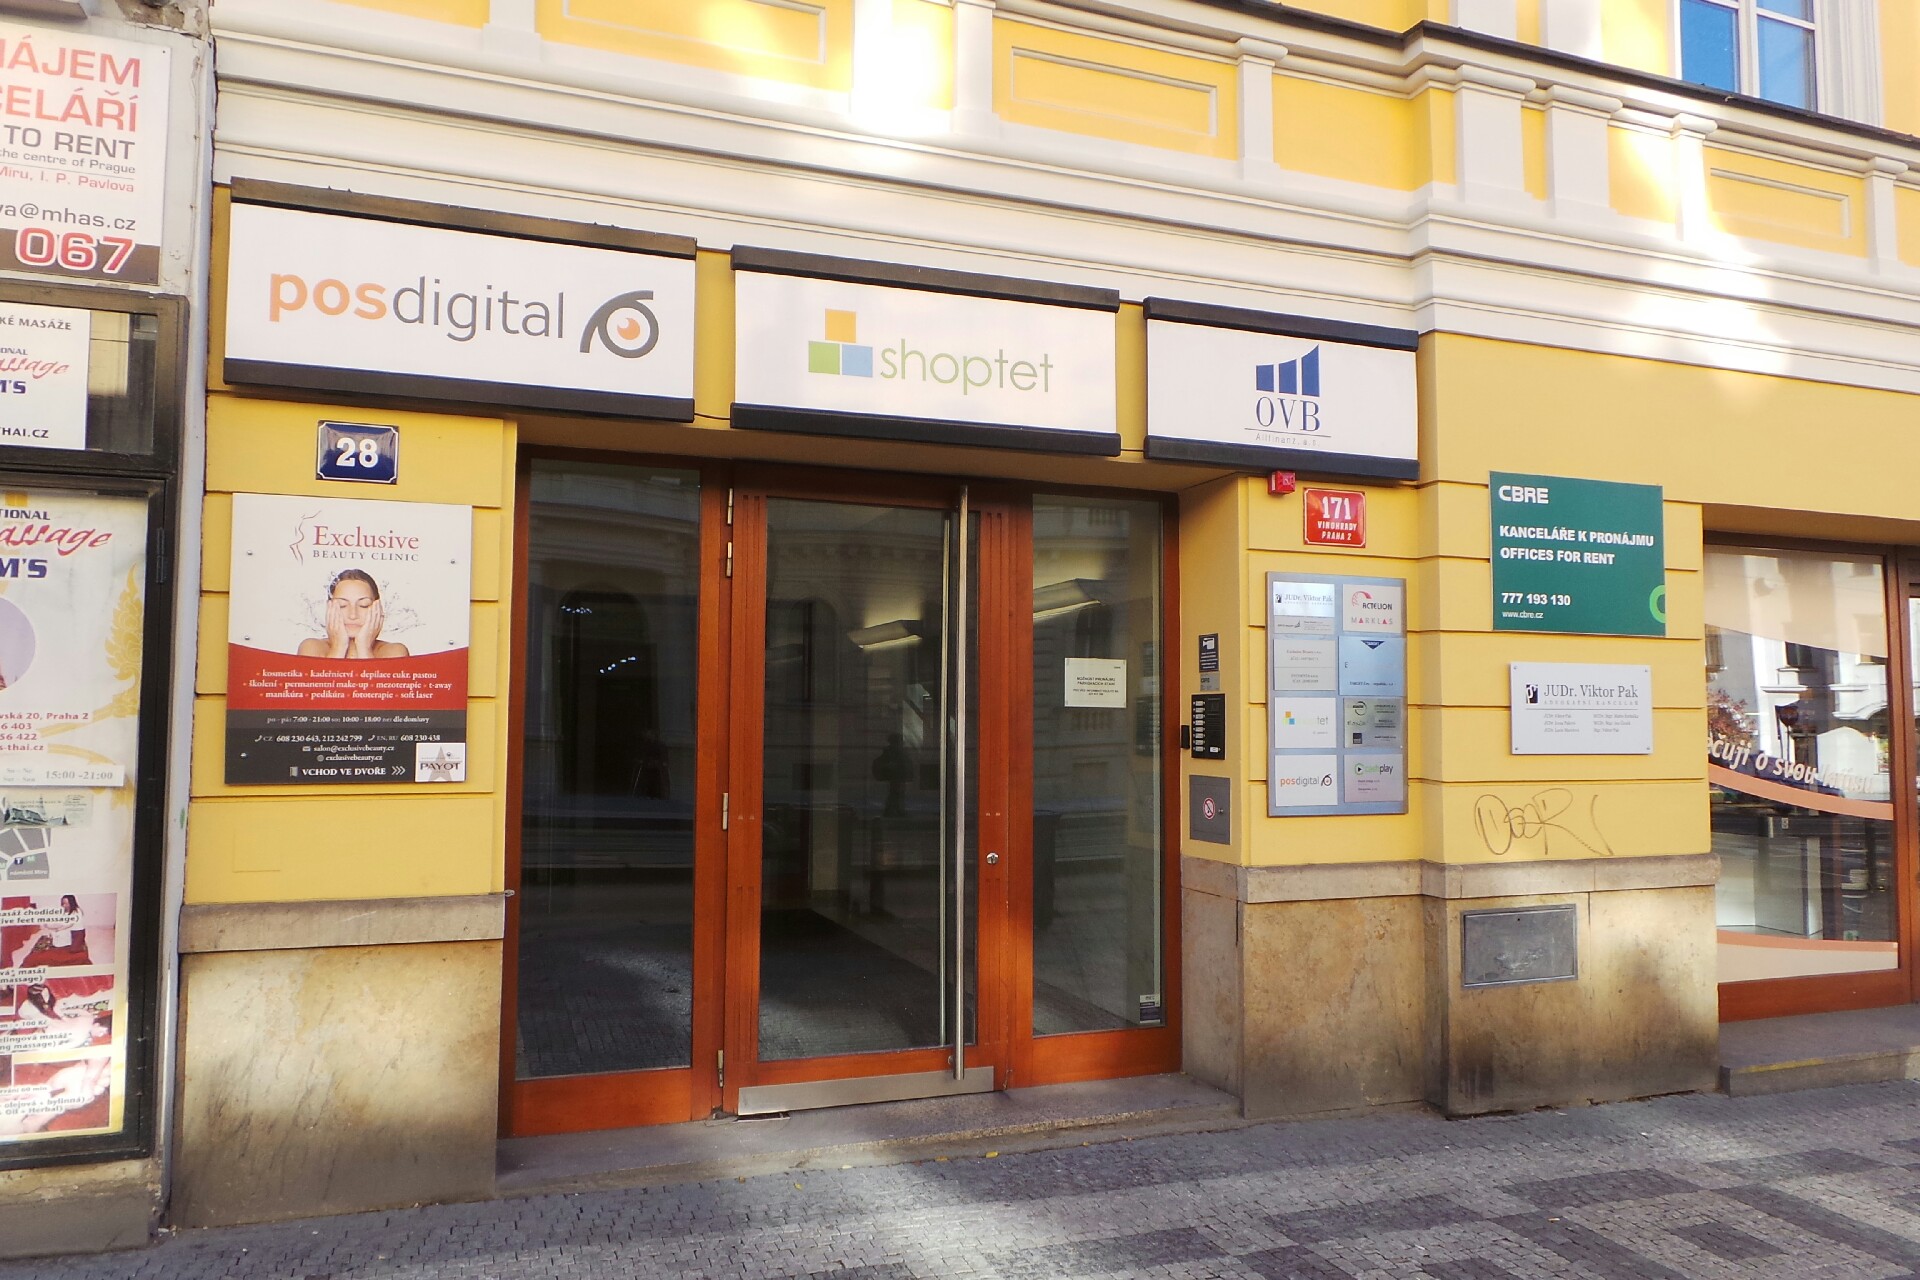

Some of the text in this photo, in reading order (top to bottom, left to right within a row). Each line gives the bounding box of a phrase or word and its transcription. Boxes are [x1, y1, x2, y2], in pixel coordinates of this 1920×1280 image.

[0, 85, 138, 133] ELÁŘÍ
[4, 125, 136, 160] TO RENT
[0, 148, 136, 174] he centre of Prague
[57, 173, 70, 185] P.
[78, 176, 134, 192] Pavlova
[17, 227, 134, 272] 067
[269, 272, 564, 342] posdigital
[19, 316, 72, 331] MASÁŽE
[881, 339, 1054, 395] shoptet
[1256, 396, 1321, 431] OVB
[336, 438, 379, 468] 28
[1498, 485, 1549, 504] CBRE
[1322, 496, 1351, 520] 171
[1317, 521, 1357, 531] VINOHRADY
[313, 525, 419, 550] Exclusive
[1322, 531, 1352, 541] PRAHA 2
[1500, 525, 1654, 547] KANCELÁŘE K PRONÁJMU
[313, 550, 419, 562] BEAUTY CLINIC
[1500, 547, 1615, 565] OFFICES FOR RENT
[1502, 592, 1571, 606] 777 193 130
[1502, 610, 1544, 619] www.cbre.cz
[262, 669, 302, 677] kosmetika
[360, 670, 391, 679] depilace
[413, 672, 437, 680] pastou
[285, 680, 334, 690] permanentní
[336, 680, 369, 690] make-up
[376, 682, 421, 691] mezoterapie
[429, 682, 452, 691] t-away
[1544, 684, 1638, 698] JUDr. Viktor Pak
[265, 690, 303, 698] manikúra
[311, 691, 344, 700] pedikúra
[352, 690, 393, 700] fototerapie
[46, 712, 79, 720] Praha
[82, 712, 89, 720] 2
[420, 762, 460, 771] PAYOT
[1755, 752, 1769, 771] o
[302, 768, 337, 776] VCHOD
[1280, 776, 1320, 787] posdigital
